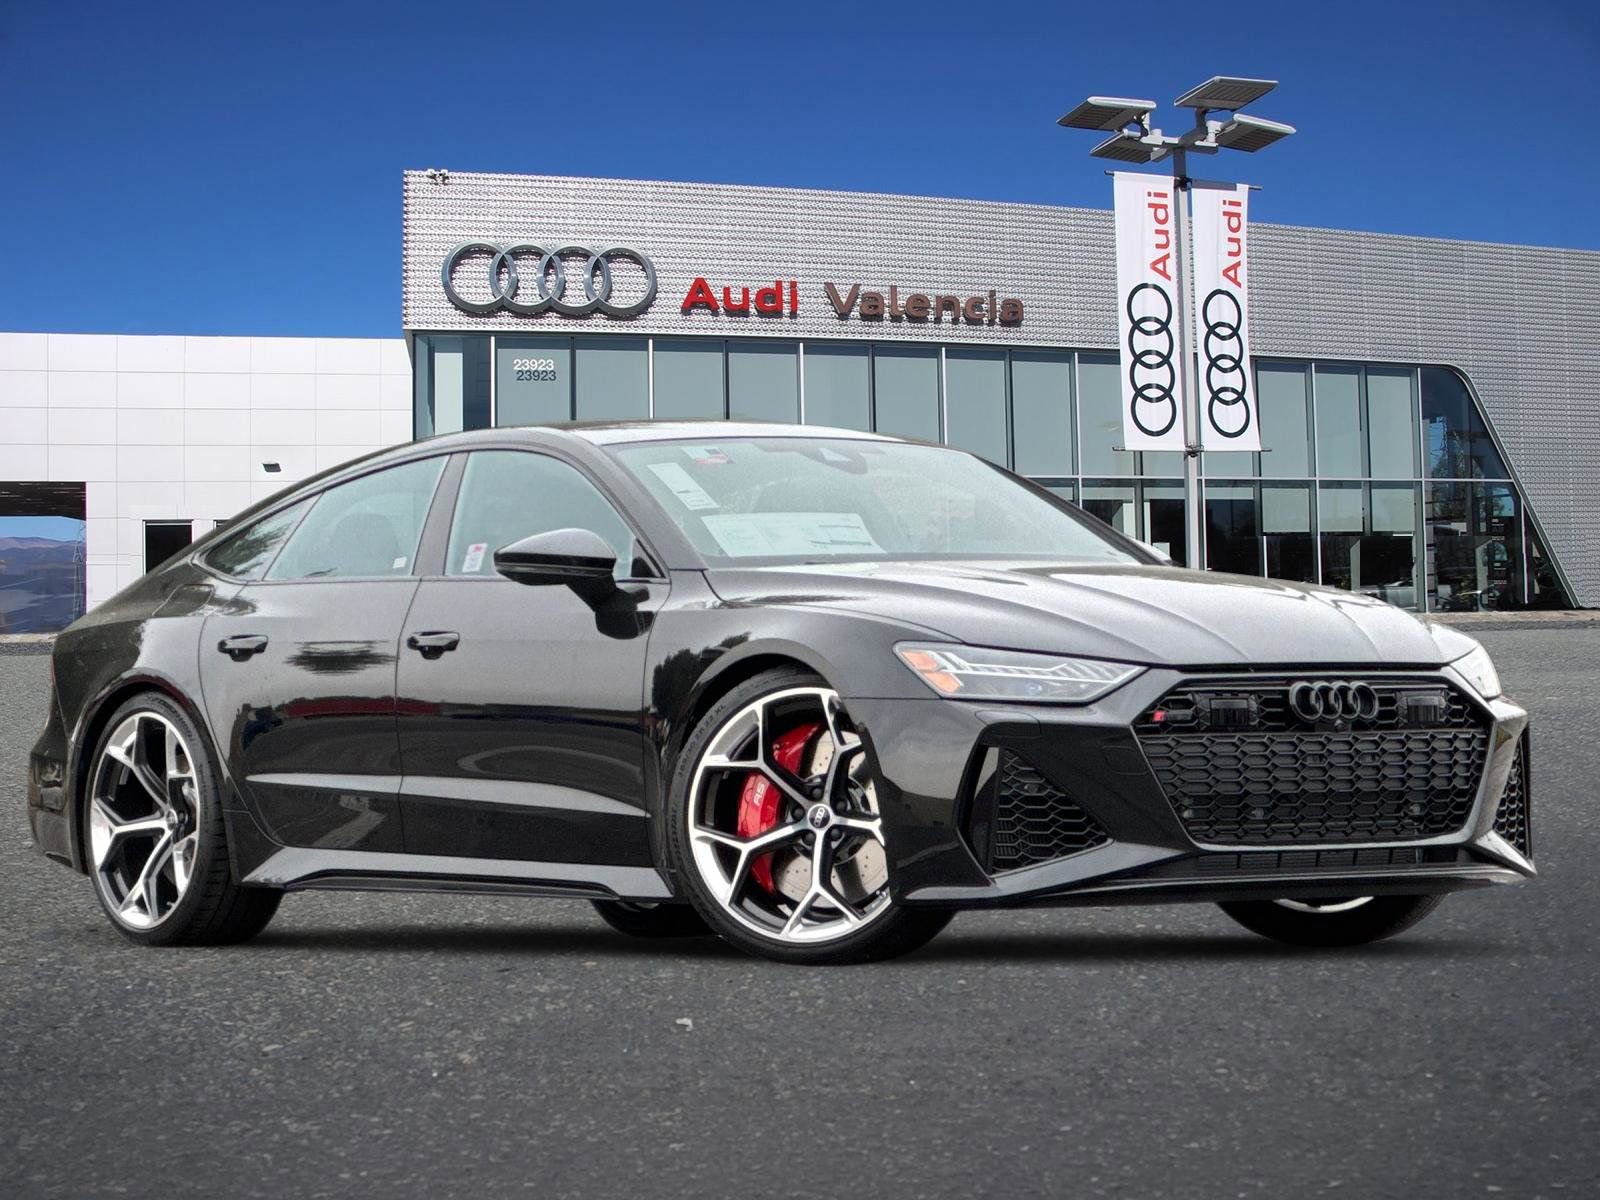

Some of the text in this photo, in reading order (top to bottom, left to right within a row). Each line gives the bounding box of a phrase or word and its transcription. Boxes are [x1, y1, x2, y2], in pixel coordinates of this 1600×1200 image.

[1147, 191, 1171, 282] Audi
[1222, 199, 1242, 288] Audi
[681, 276, 1025, 325] Audi Valencia
[513, 359, 554, 370] 23923
[516, 370, 556, 381] 23923
